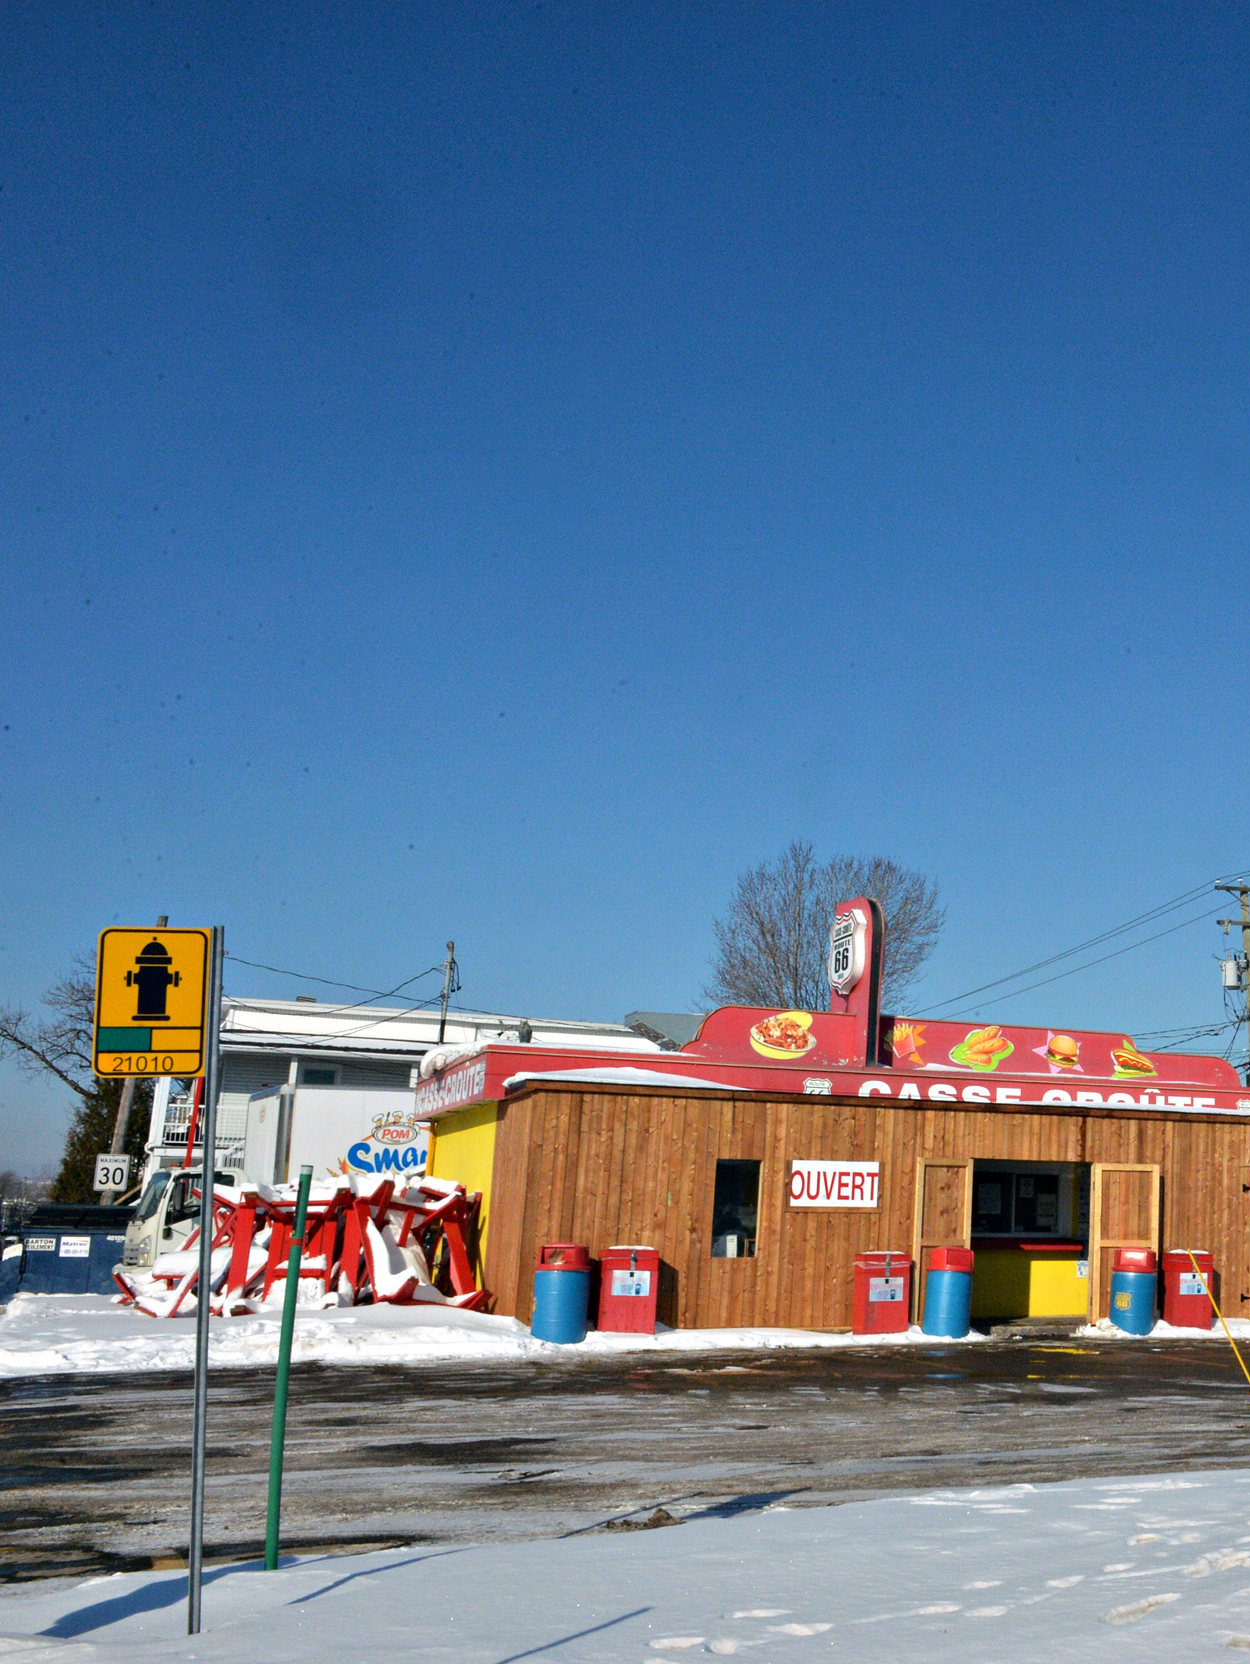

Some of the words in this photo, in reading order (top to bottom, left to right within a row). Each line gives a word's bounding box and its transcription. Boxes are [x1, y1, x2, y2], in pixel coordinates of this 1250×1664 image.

[834, 947, 849, 974] 66
[112, 1056, 174, 1072] 21010
[381, 1128, 410, 1140] POM
[98, 1167, 124, 1185] 30
[790, 1170, 879, 1201] OUVERT
